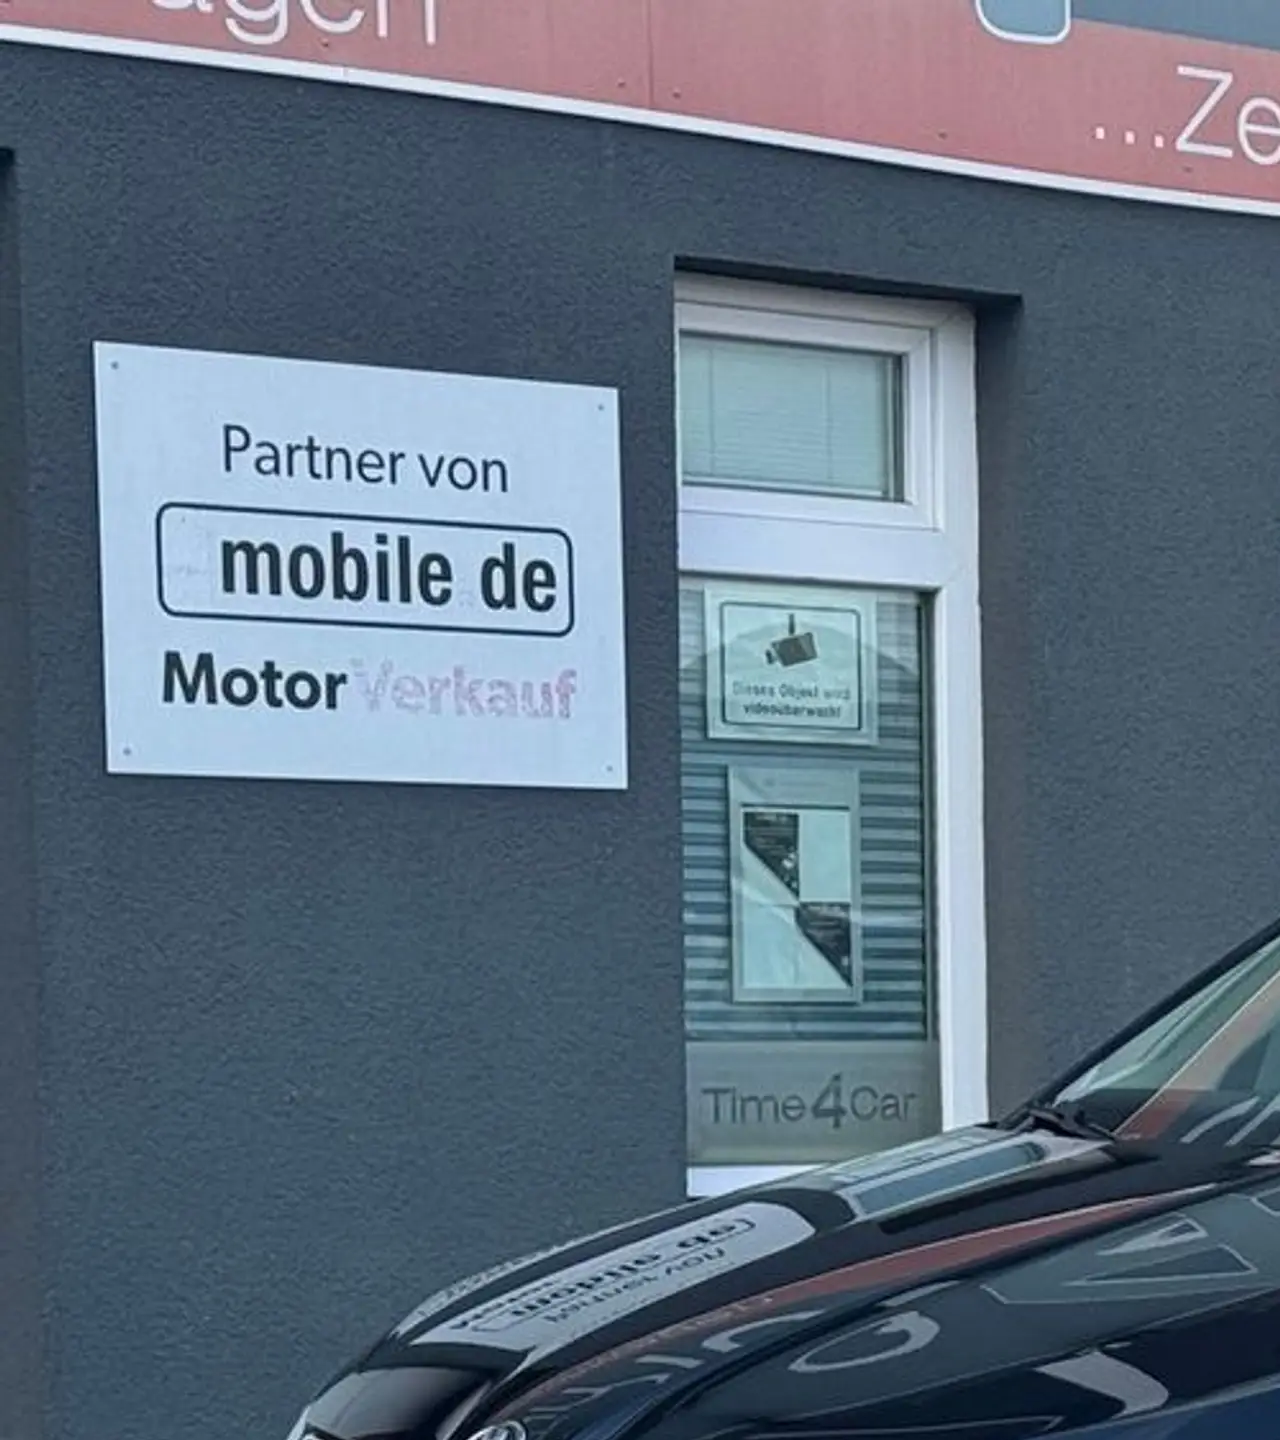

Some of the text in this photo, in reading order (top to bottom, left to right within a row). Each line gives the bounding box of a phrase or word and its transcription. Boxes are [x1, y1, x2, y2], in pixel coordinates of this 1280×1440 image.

[222, 423, 509, 493] Partner von
[221, 531, 557, 612] mobile de
[700, 1071, 918, 1130] Time4Car
